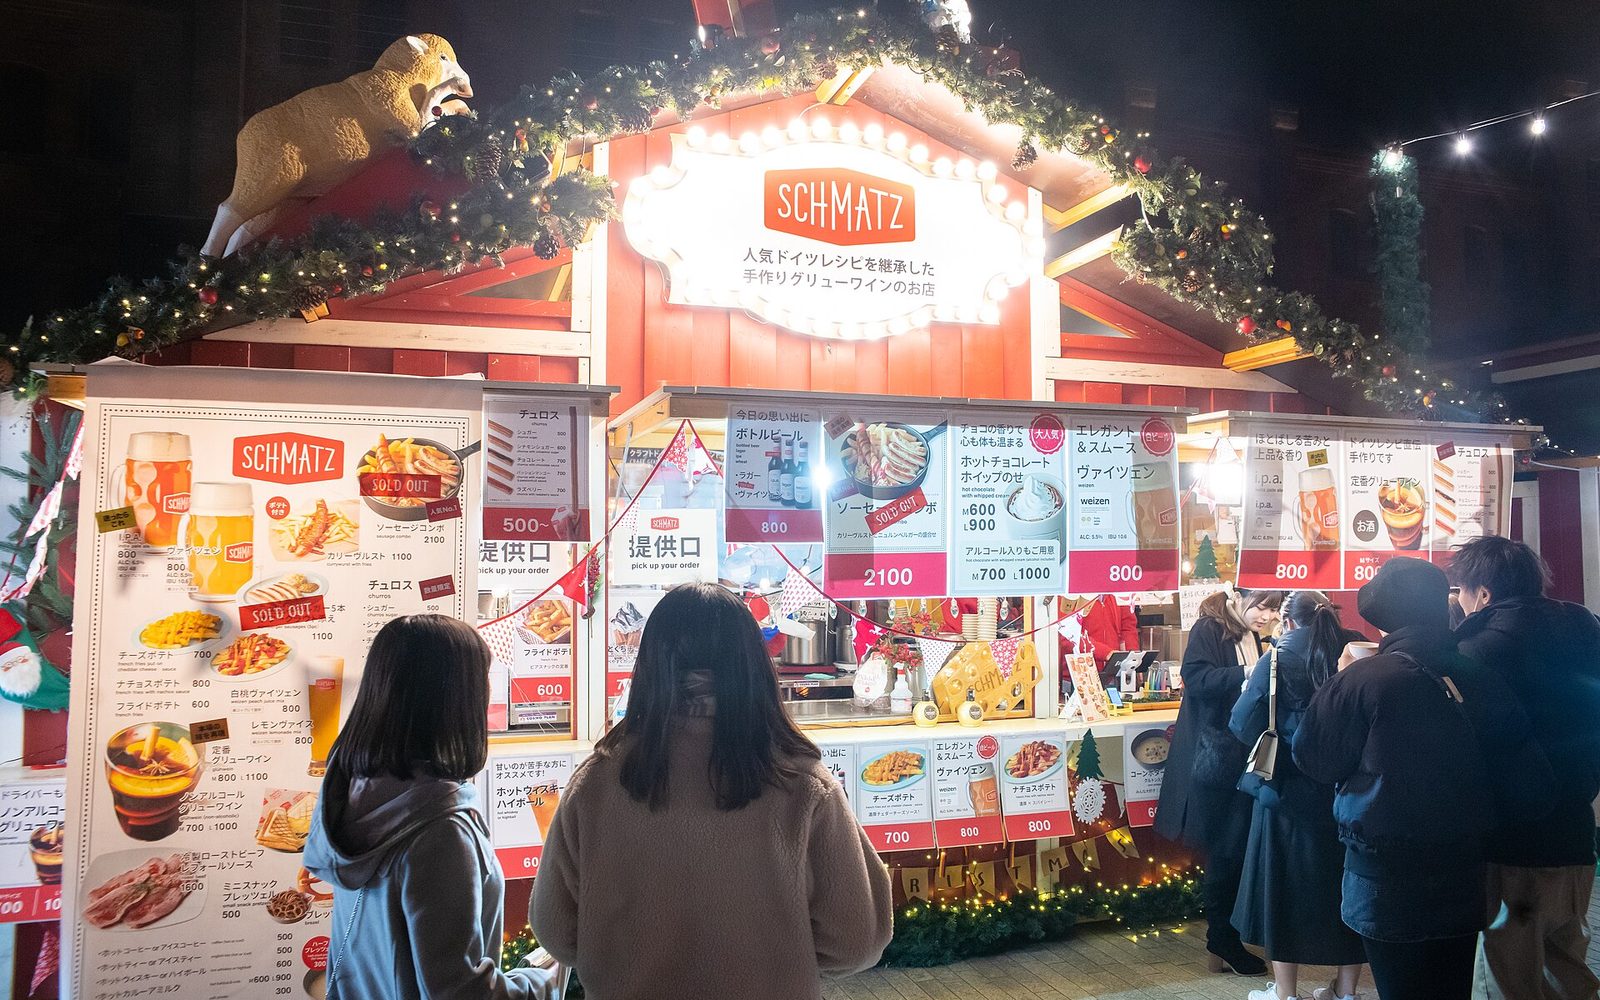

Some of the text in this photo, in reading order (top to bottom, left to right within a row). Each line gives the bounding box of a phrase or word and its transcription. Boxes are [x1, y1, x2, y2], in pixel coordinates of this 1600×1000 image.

[778, 180, 904, 232] SCHMATZ
[743, 247, 935, 277] 人気ドイツレシピを継承した
[743, 269, 936, 297] 手作りグリューワインのお店
[519, 409, 560, 421] チュロス
[736, 409, 810, 423] 今日の思い出に
[961, 423, 1024, 435] チョコの香りで
[1076, 425, 1136, 438] エレガント
[735, 428, 804, 442] ボトルビール
[1035, 430, 1060, 440] 大人気
[1255, 433, 1331, 447] ほとばしる苦みと
[960, 436, 1024, 448] 心も体も温まる
[1350, 437, 1422, 450] ドイツレシピ直伝
[1255, 448, 1304, 461] 上品な香り
[1349, 451, 1394, 464] 手作りです
[1457, 447, 1489, 458] チュロス
[241, 441, 336, 476] SCHMATZ
[960, 455, 1051, 469] ホットチョコレート
[960, 471, 1024, 484] ホイップのせ
[1076, 464, 1156, 480] ヴァイツェン
[371, 478, 430, 493] SOLD OUT
[1350, 476, 1422, 488] 定番グリューワイン
[1080, 496, 1110, 506] weizen
[271, 508, 285, 516] 付き
[430, 505, 459, 516] 人気No.1
[875, 507, 899, 527] SOLD
[899, 496, 918, 515] OUT
[376, 524, 445, 533] ソーセージコンボ
[652, 520, 679, 529] SCHMATZ
[761, 521, 788, 534] 800
[1356, 520, 1376, 533] お酒
[423, 536, 445, 544] 2100
[166, 546, 222, 556] ヴァイツェン
[628, 535, 701, 559] 提供口
[965, 545, 1055, 556] アルコール入りもご用意
[117, 551, 137, 559] 800
[326, 552, 386, 561] カリーヴルスト
[391, 552, 413, 561] 1100
[166, 563, 186, 571] 800
[507, 567, 527, 576] your
[527, 566, 550, 574] order
[631, 562, 700, 571] pick up your order
[1275, 564, 1309, 580] 800
[863, 568, 913, 587] 2100
[1108, 564, 1143, 582] 800
[368, 580, 413, 590] チュロス
[252, 608, 285, 623] SOLD
[288, 602, 312, 618] OUT
[118, 651, 174, 660] チーズポテト
[193, 651, 212, 659] 700
[116, 680, 181, 689] ナチョスポテト
[192, 680, 211, 688] 800
[230, 689, 302, 699] 白桃ヴァイツェン
[537, 684, 563, 696] 600
[116, 701, 181, 711] フライドポテト
[191, 700, 210, 708] 600
[282, 705, 301, 713] 800
[251, 720, 314, 730] レモンヴァイス
[294, 736, 314, 745] 800
[211, 745, 231, 755] 定番
[936, 742, 974, 751] エレガント
[211, 755, 272, 765] グリューワイン
[495, 760, 567, 772] 甘いのが苦手な方に
[936, 766, 987, 777] ヴァイツェン
[1012, 783, 1056, 793] ナチョスポテト
[1, 789, 64, 800] ドライバーも
[180, 790, 246, 801] ノンアルコール
[872, 793, 915, 803] チーズポテト
[179, 802, 243, 814] グリューワイン
[496, 797, 545, 809] ハイボール
[1028, 819, 1051, 833] 800
[884, 831, 910, 844] 700
[960, 827, 979, 838] 800
[181, 850, 265, 862] 冷製ローストビーフ
[181, 861, 254, 873] レフォールソース
[181, 882, 204, 892] 1600
[222, 879, 278, 891] ミニスナック
[223, 890, 277, 902] プレッツェル
[0, 900, 23, 915] 00
[222, 910, 241, 919] 500
[276, 933, 293, 941] 500
[276, 947, 293, 955] 500
[276, 960, 293, 968] 600
[275, 986, 292, 995] 300
